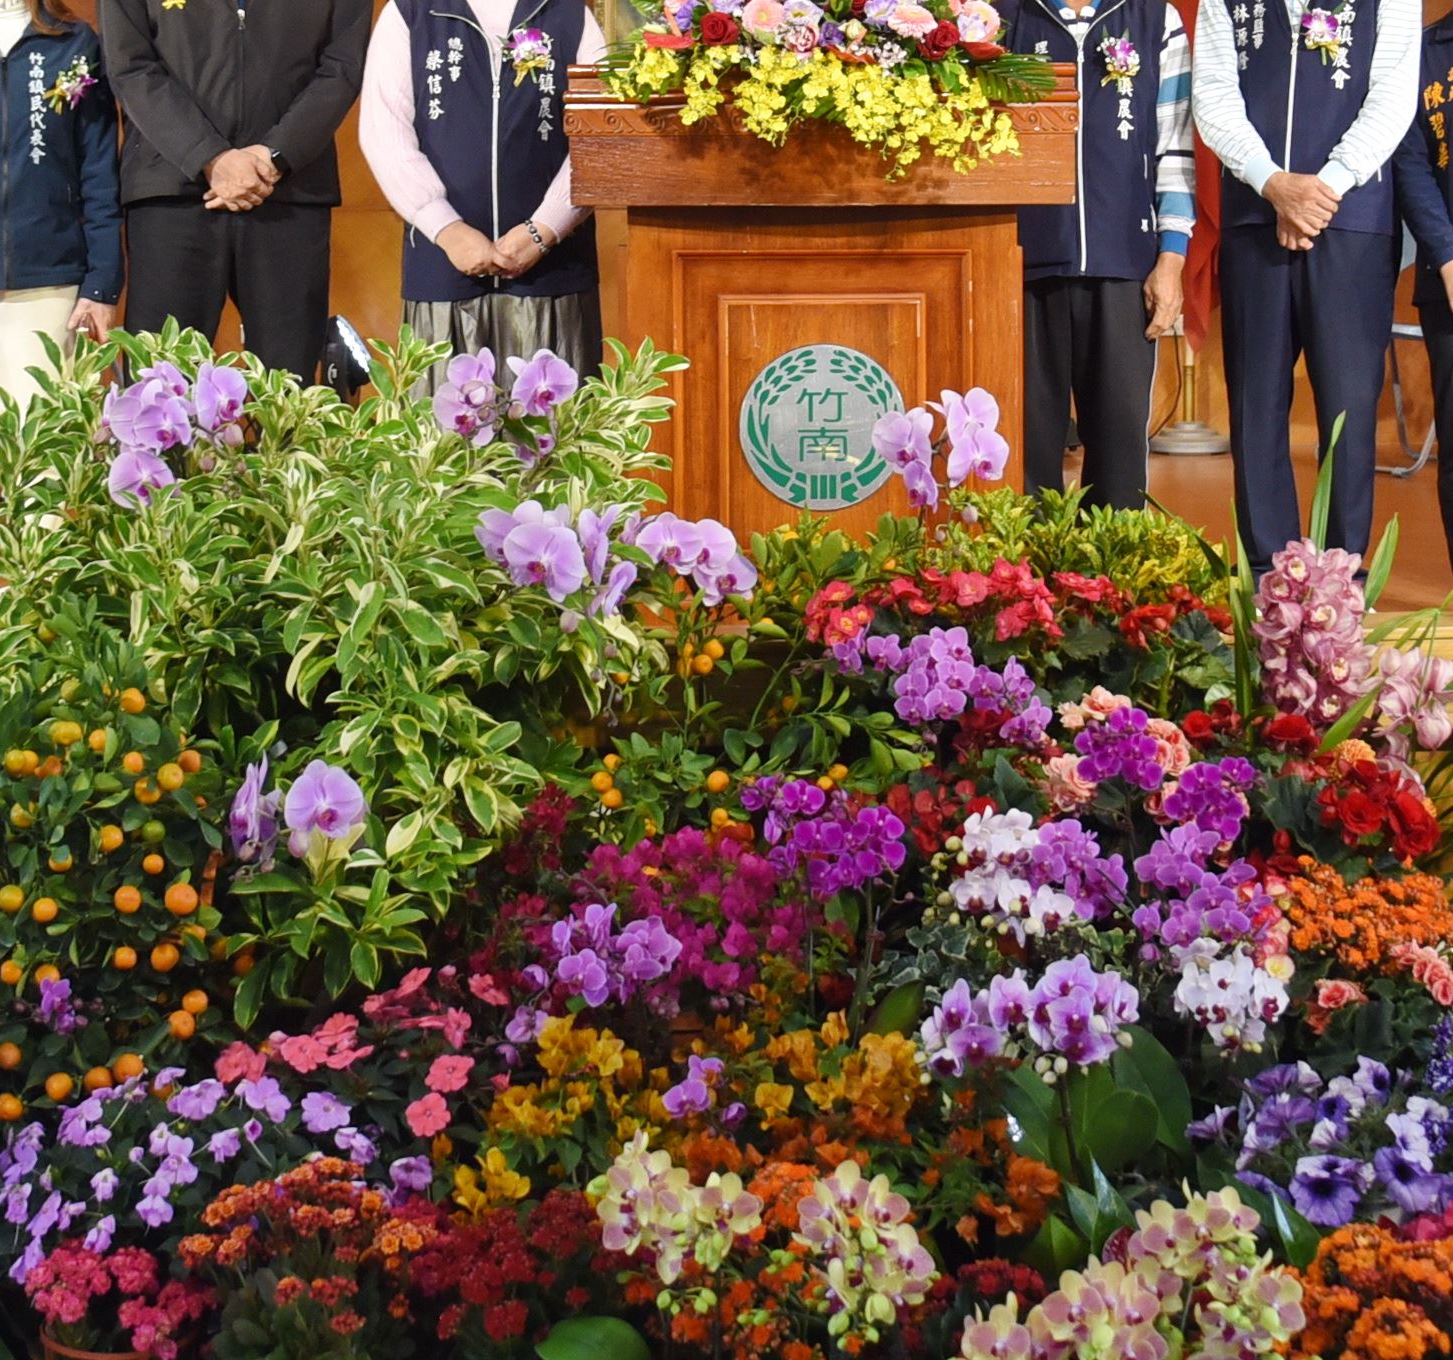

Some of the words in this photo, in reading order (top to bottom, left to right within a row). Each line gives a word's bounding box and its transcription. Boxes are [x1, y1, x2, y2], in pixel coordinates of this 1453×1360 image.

[426, 49, 445, 120] 蔡信芬
[447, 36, 464, 83] 總幹事
[28, 51, 47, 166] 竹南鎮民代表會
[796, 388, 849, 462] 竹南
